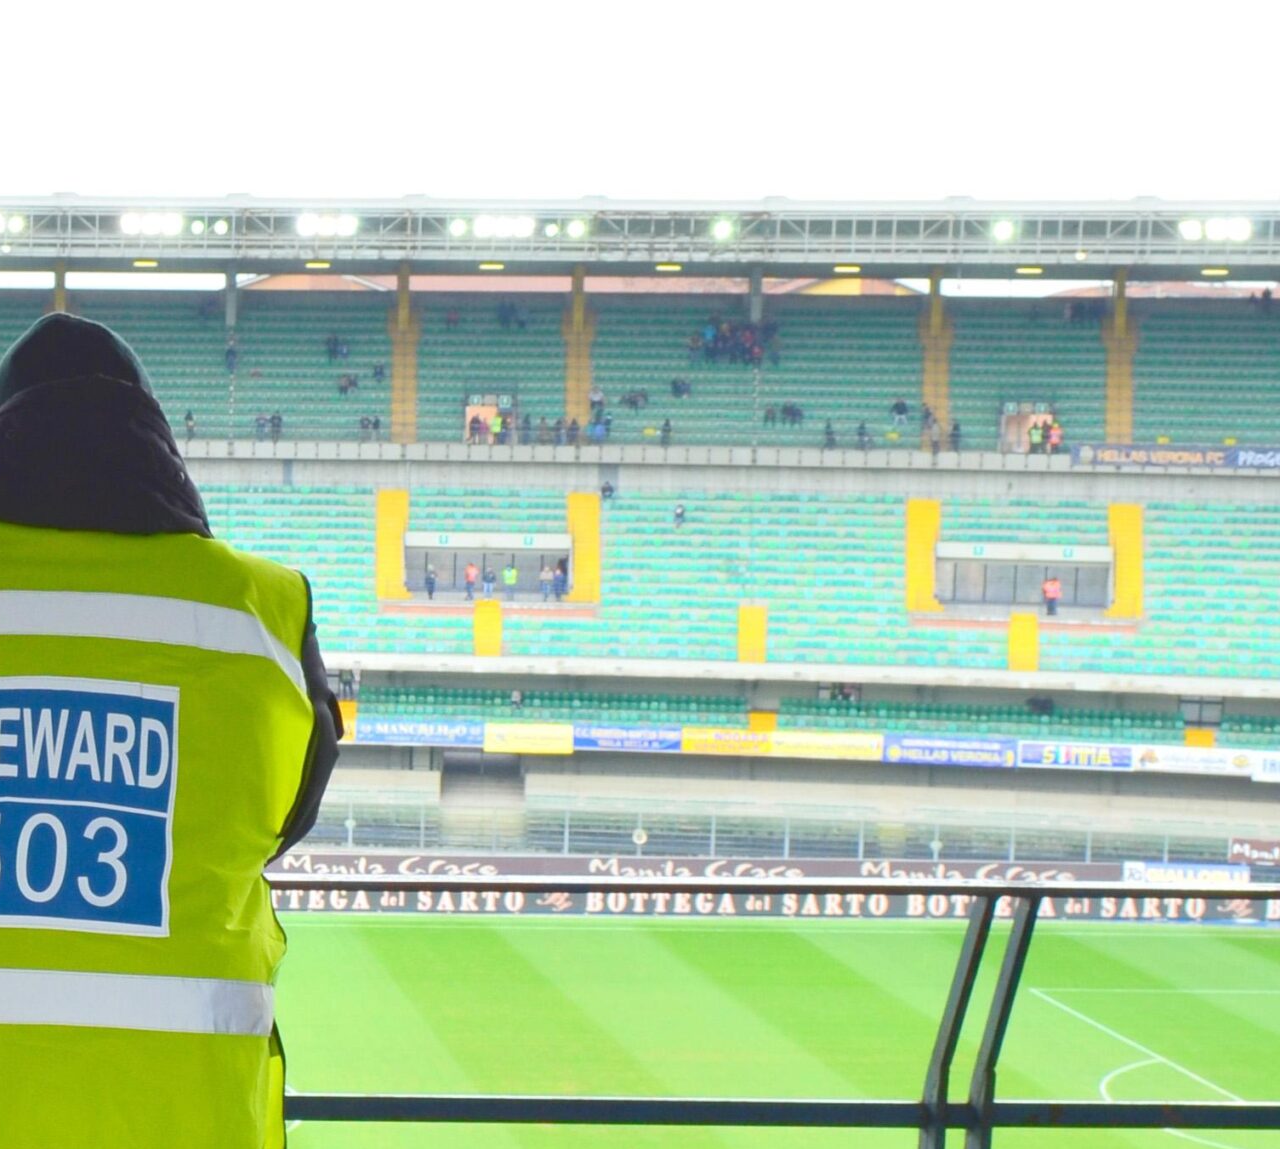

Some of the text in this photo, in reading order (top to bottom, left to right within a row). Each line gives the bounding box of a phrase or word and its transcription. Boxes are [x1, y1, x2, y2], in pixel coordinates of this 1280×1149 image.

[282, 855, 499, 876] Manila Grace
[589, 858, 804, 879] Manila Grace
[861, 861, 1075, 882] Manila Grace
[271, 889, 524, 911] TTEGA del SARTO
[586, 892, 889, 916] BOTTEGA del SARTO
[907, 895, 1206, 918] BOTEA del SARTO
